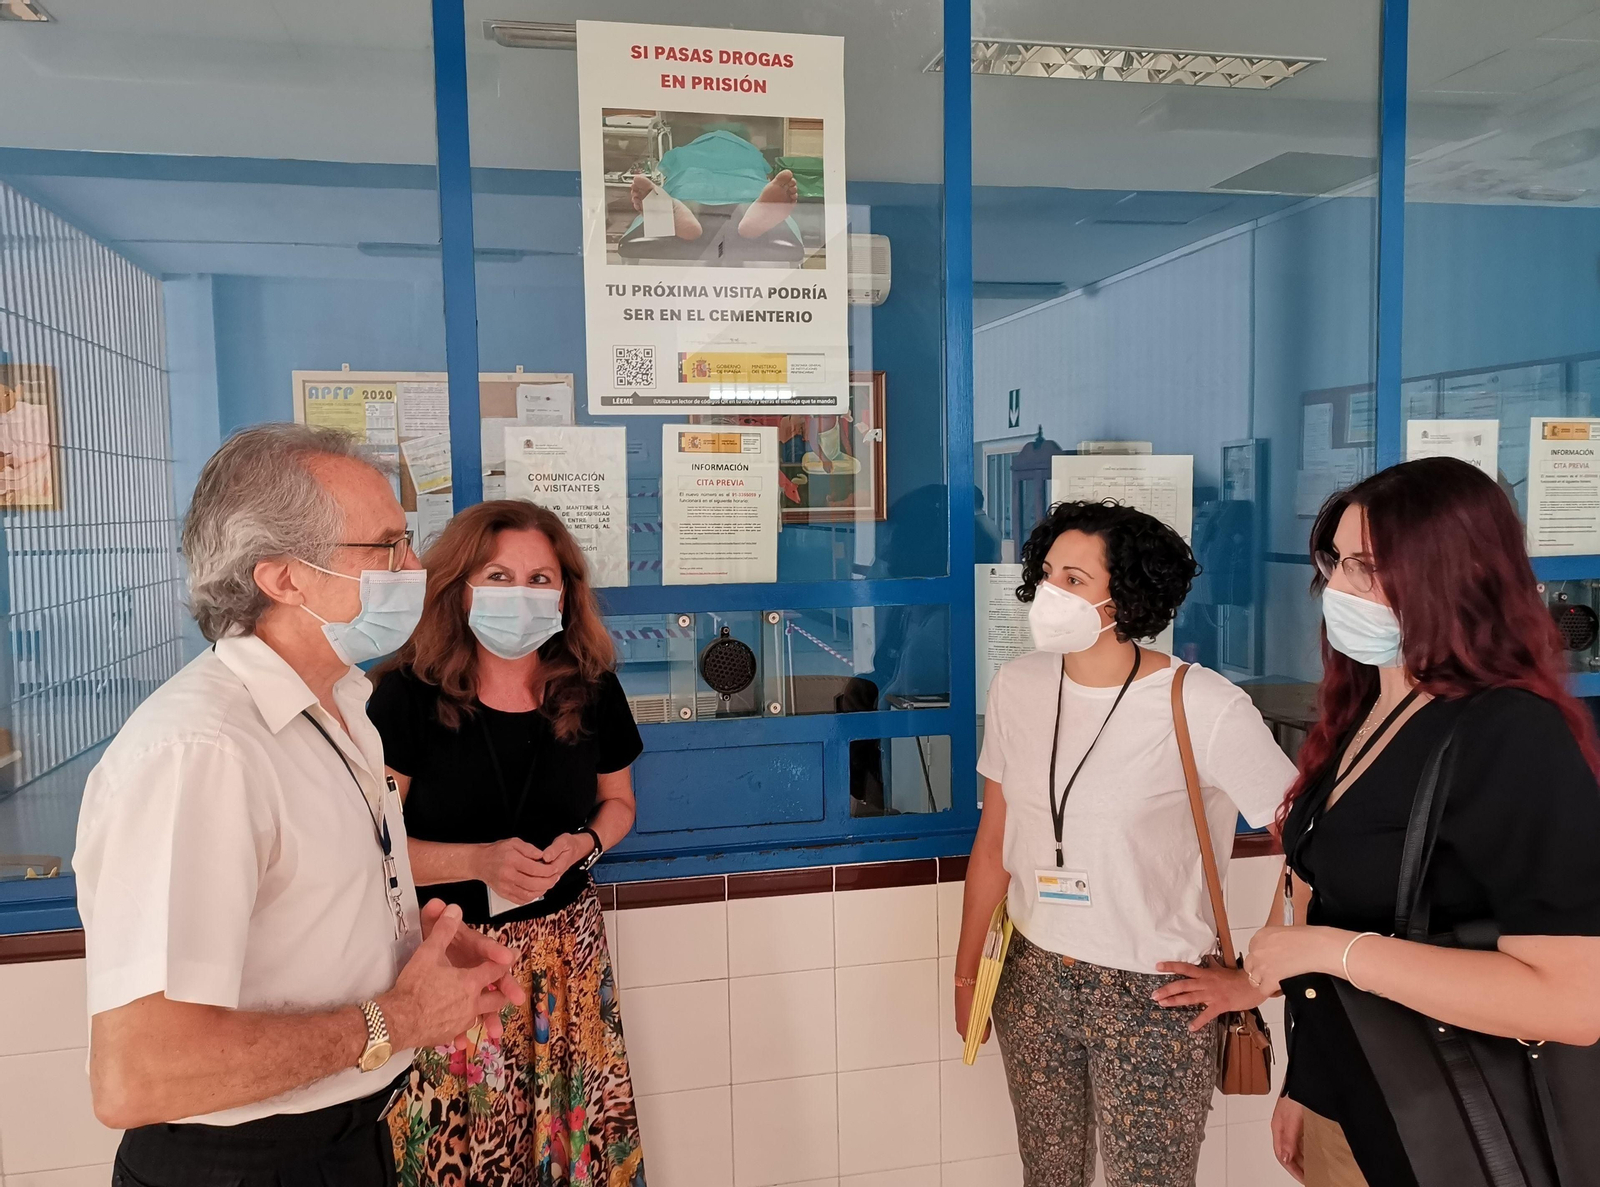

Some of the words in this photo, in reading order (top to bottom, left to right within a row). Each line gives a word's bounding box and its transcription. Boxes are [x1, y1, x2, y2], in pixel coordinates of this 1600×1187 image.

[630, 45, 649, 60] SI
[654, 46, 714, 64] PASAS
[718, 50, 794, 68] DROGAS
[660, 74, 686, 89] EN
[691, 75, 767, 93] PRISIÓN
[605, 284, 627, 297] TU
[631, 281, 709, 298] PRÓXIMA
[712, 286, 763, 299] VISITA
[767, 284, 828, 300] PODRÍA
[623, 308, 655, 321] SER
[659, 309, 682, 321] EN
[686, 309, 705, 322] EL
[709, 309, 813, 323] CEMENTERIO
[307, 386, 355, 400] APFP
[362, 390, 393, 400] 2020
[691, 463, 749, 471] INFORMACIÓN
[527, 472, 605, 482] COMUNICACIÓN
[543, 484, 600, 493] VISITANTES
